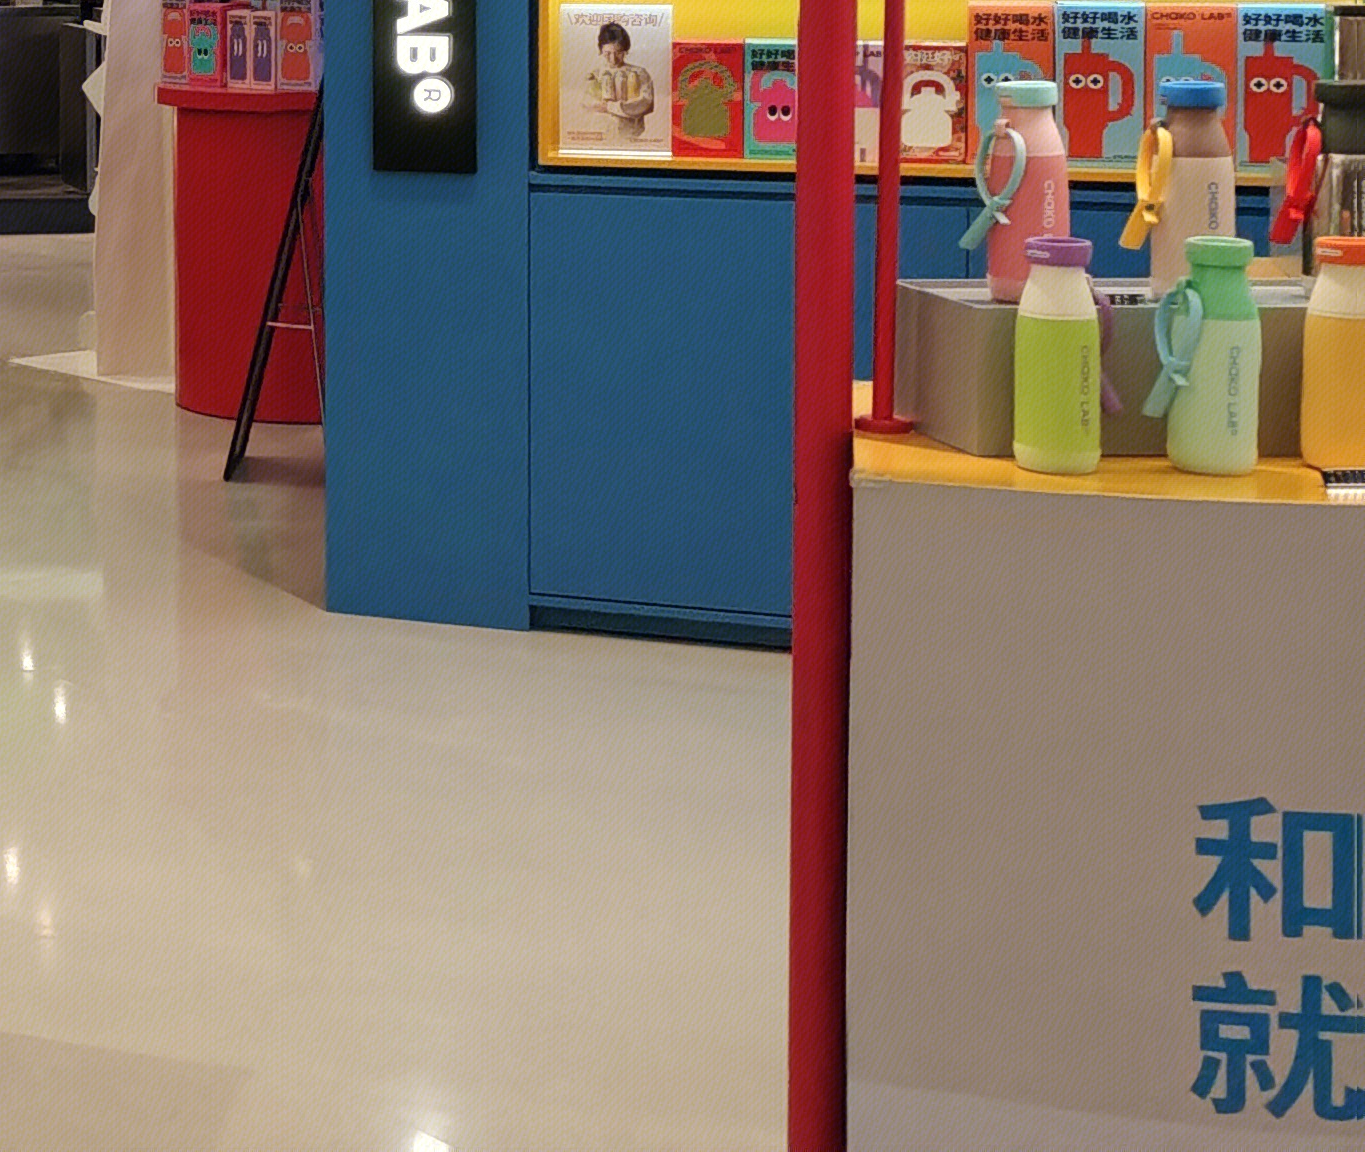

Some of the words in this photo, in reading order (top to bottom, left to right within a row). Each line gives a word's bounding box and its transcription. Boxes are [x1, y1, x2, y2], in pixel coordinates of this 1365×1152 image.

[973, 13, 1049, 26] 好好喝水
[1061, 11, 1139, 25] 好好喝水
[1242, 12, 1325, 28] 好好喝水
